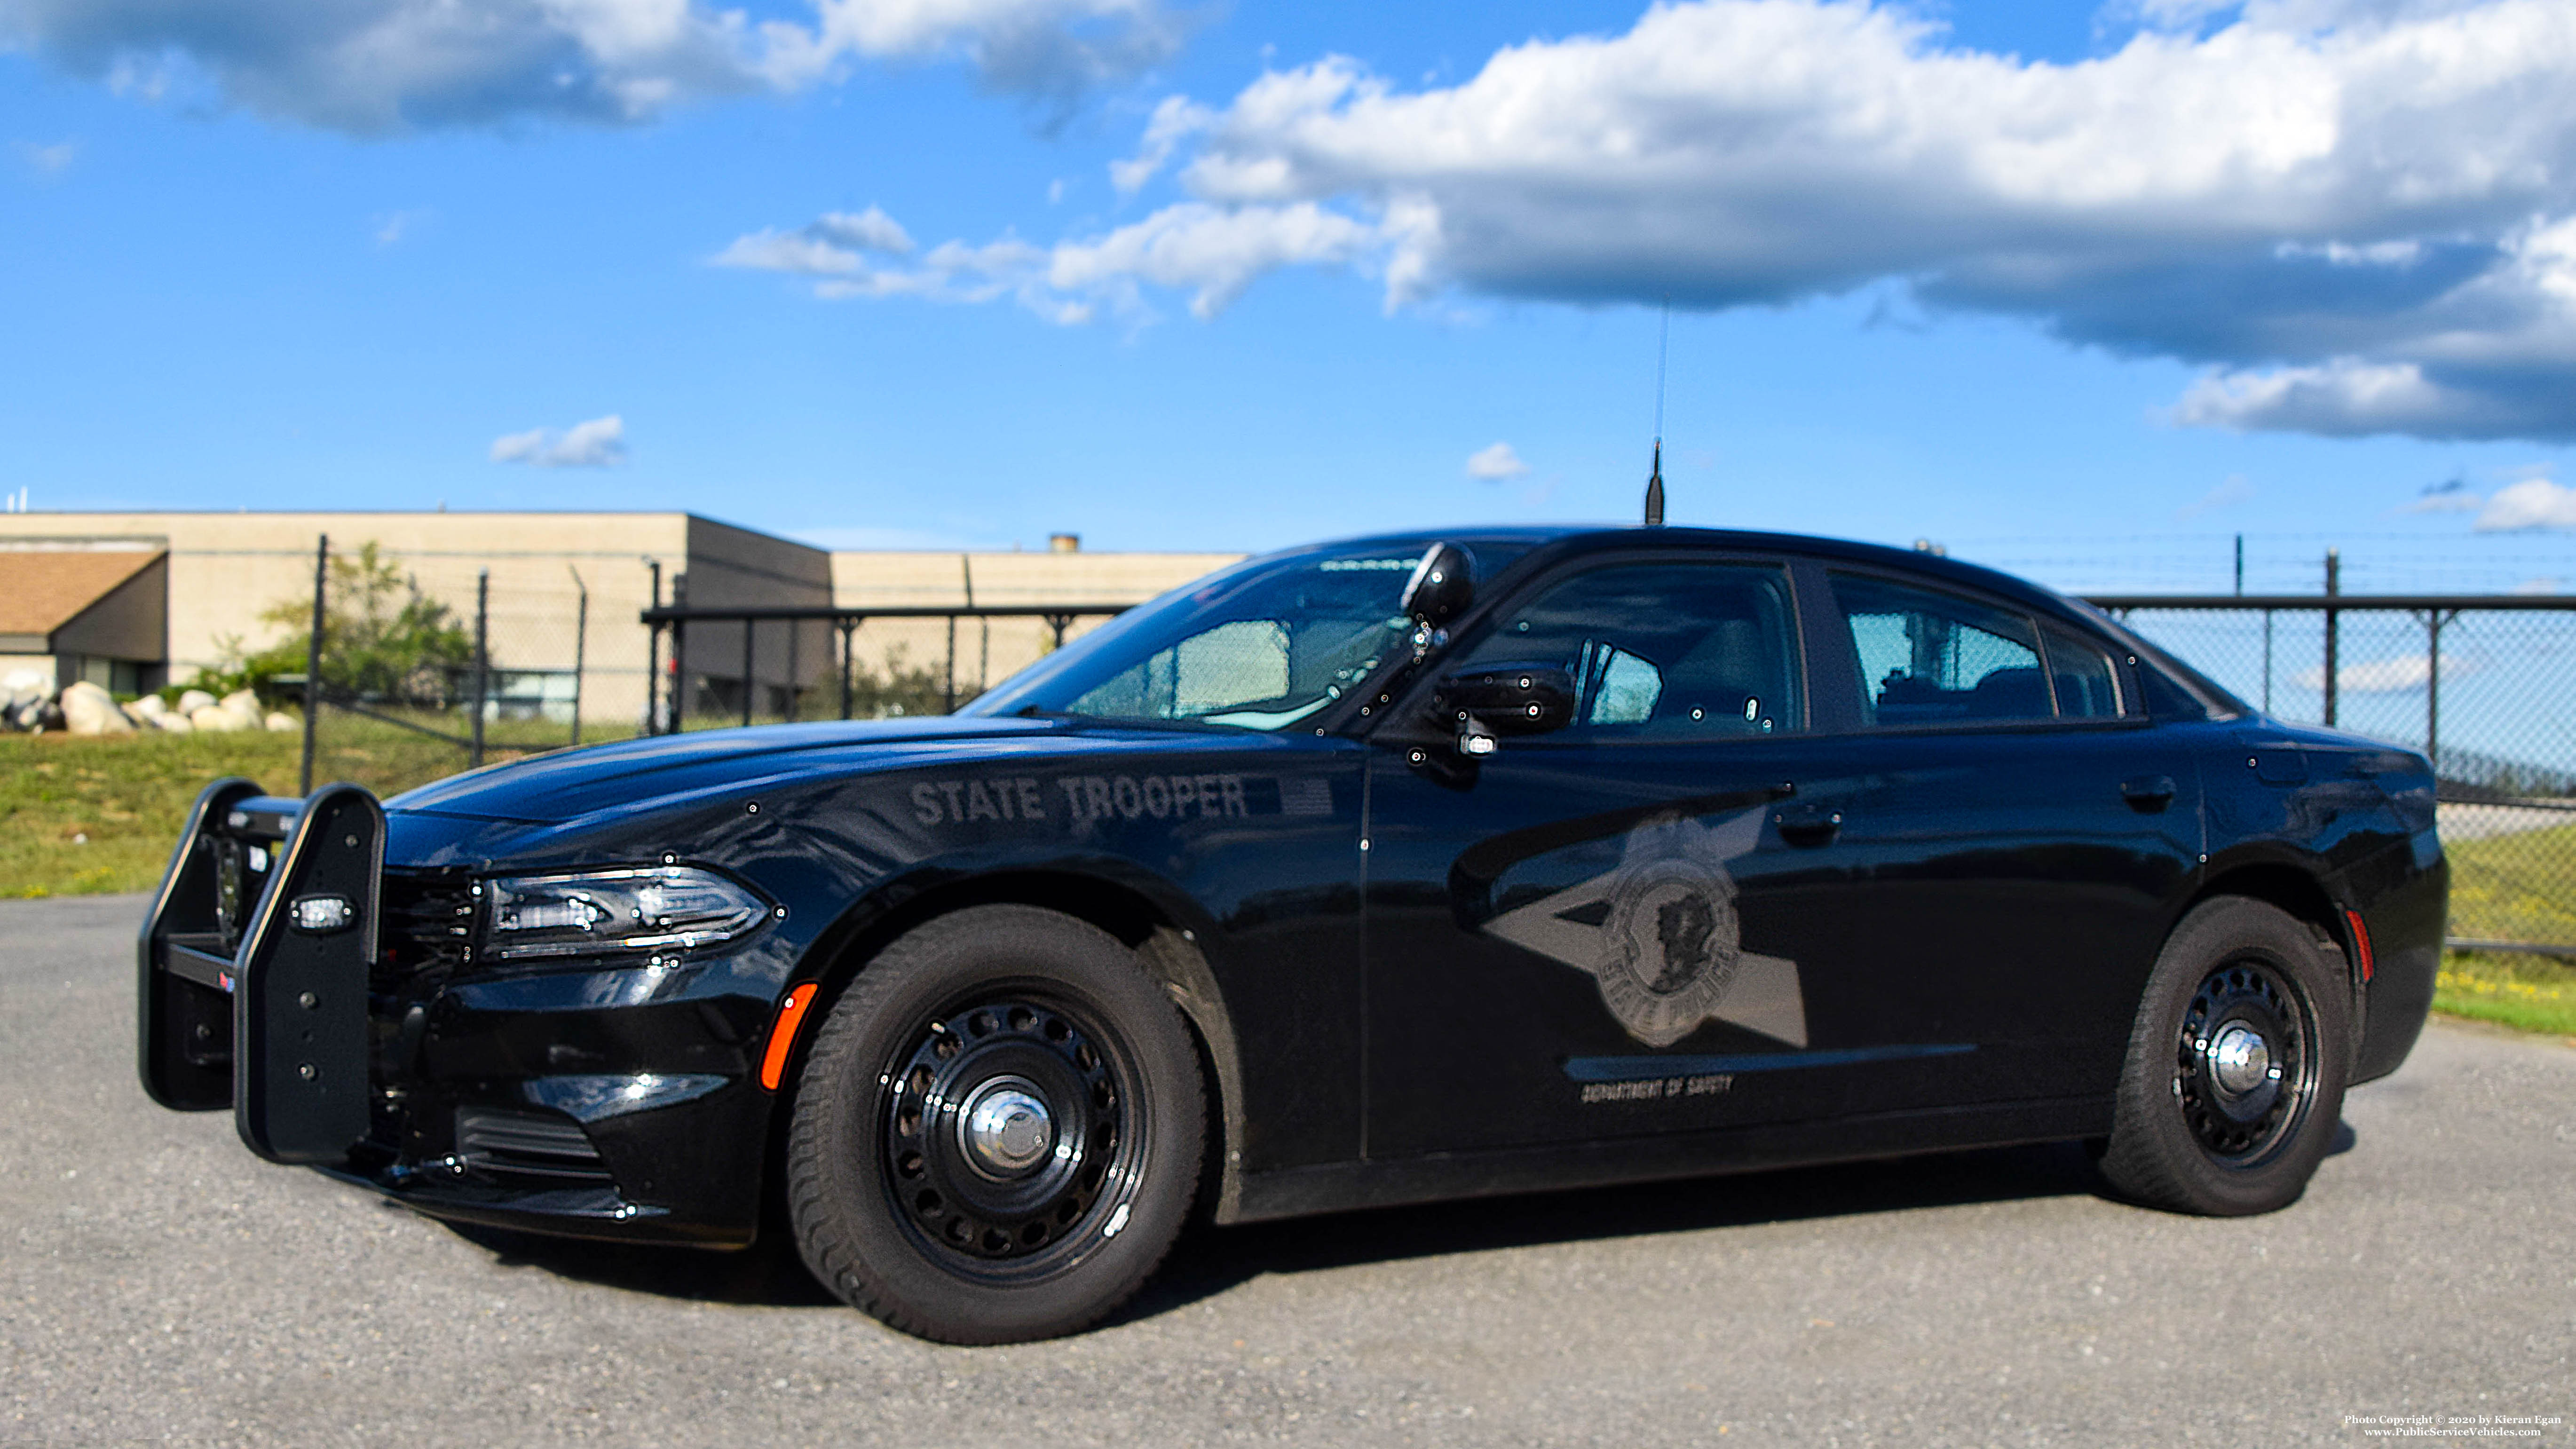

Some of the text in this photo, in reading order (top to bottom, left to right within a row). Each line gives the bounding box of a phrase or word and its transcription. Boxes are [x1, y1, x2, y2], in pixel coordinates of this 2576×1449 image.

[911, 773, 1248, 824] STATE TROOPER
[1581, 1074, 1734, 1102] DEPARTMENT OF SAFETY
